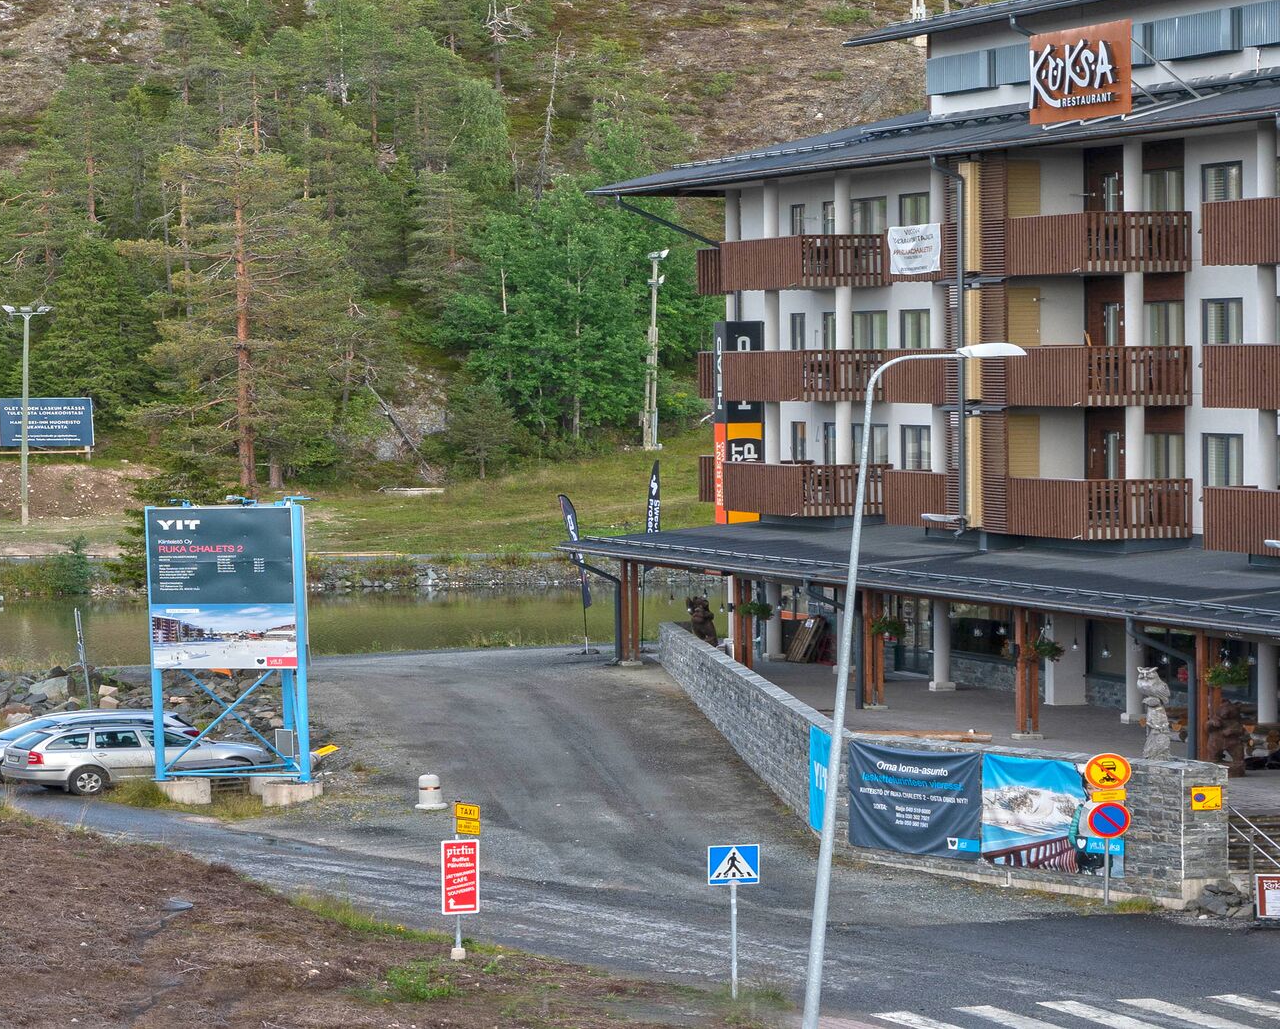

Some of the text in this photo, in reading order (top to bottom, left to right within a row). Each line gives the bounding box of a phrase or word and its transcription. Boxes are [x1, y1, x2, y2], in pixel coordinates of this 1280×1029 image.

[1029, 39, 1113, 109] KUKSA
[1062, 92, 1112, 107] RESTAURANT
[157, 520, 200, 530] YIT
[159, 545, 244, 553] RUKA CHALETS 2
[876, 761, 948, 777] Oma loma-asunto
[903, 791, 922, 800] CHALETS
[461, 808, 475, 816] TAXI
